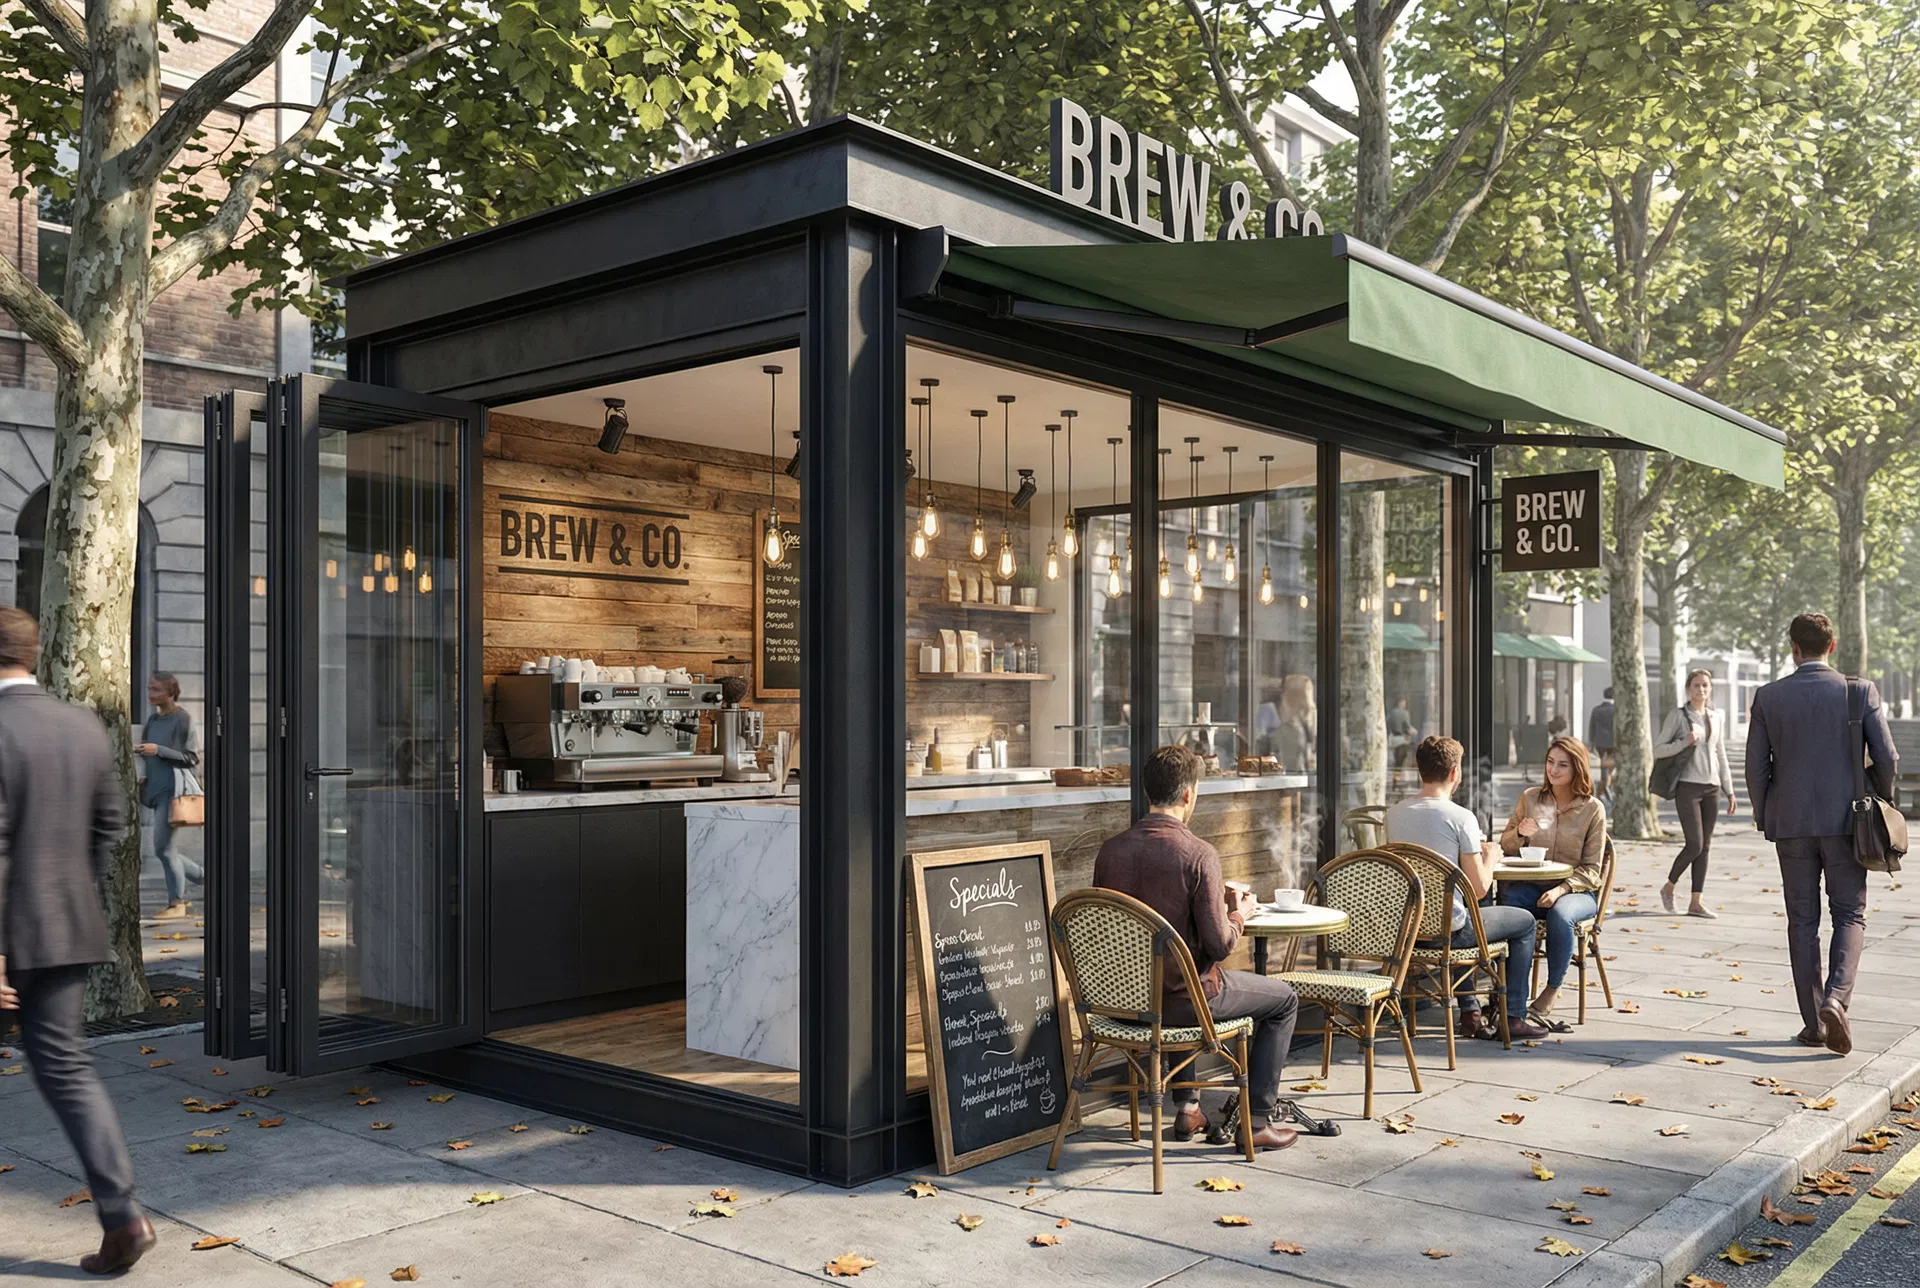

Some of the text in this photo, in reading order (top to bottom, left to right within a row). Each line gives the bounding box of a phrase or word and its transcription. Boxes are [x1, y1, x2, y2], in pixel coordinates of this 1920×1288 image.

[1060, 97, 1211, 242] BREW
[1224, 180, 1257, 240] &
[1515, 488, 1586, 522] BREW
[500, 509, 690, 569] BREW & CO.
[1516, 523, 1580, 555] & CO.
[950, 867, 1023, 917] Specials
